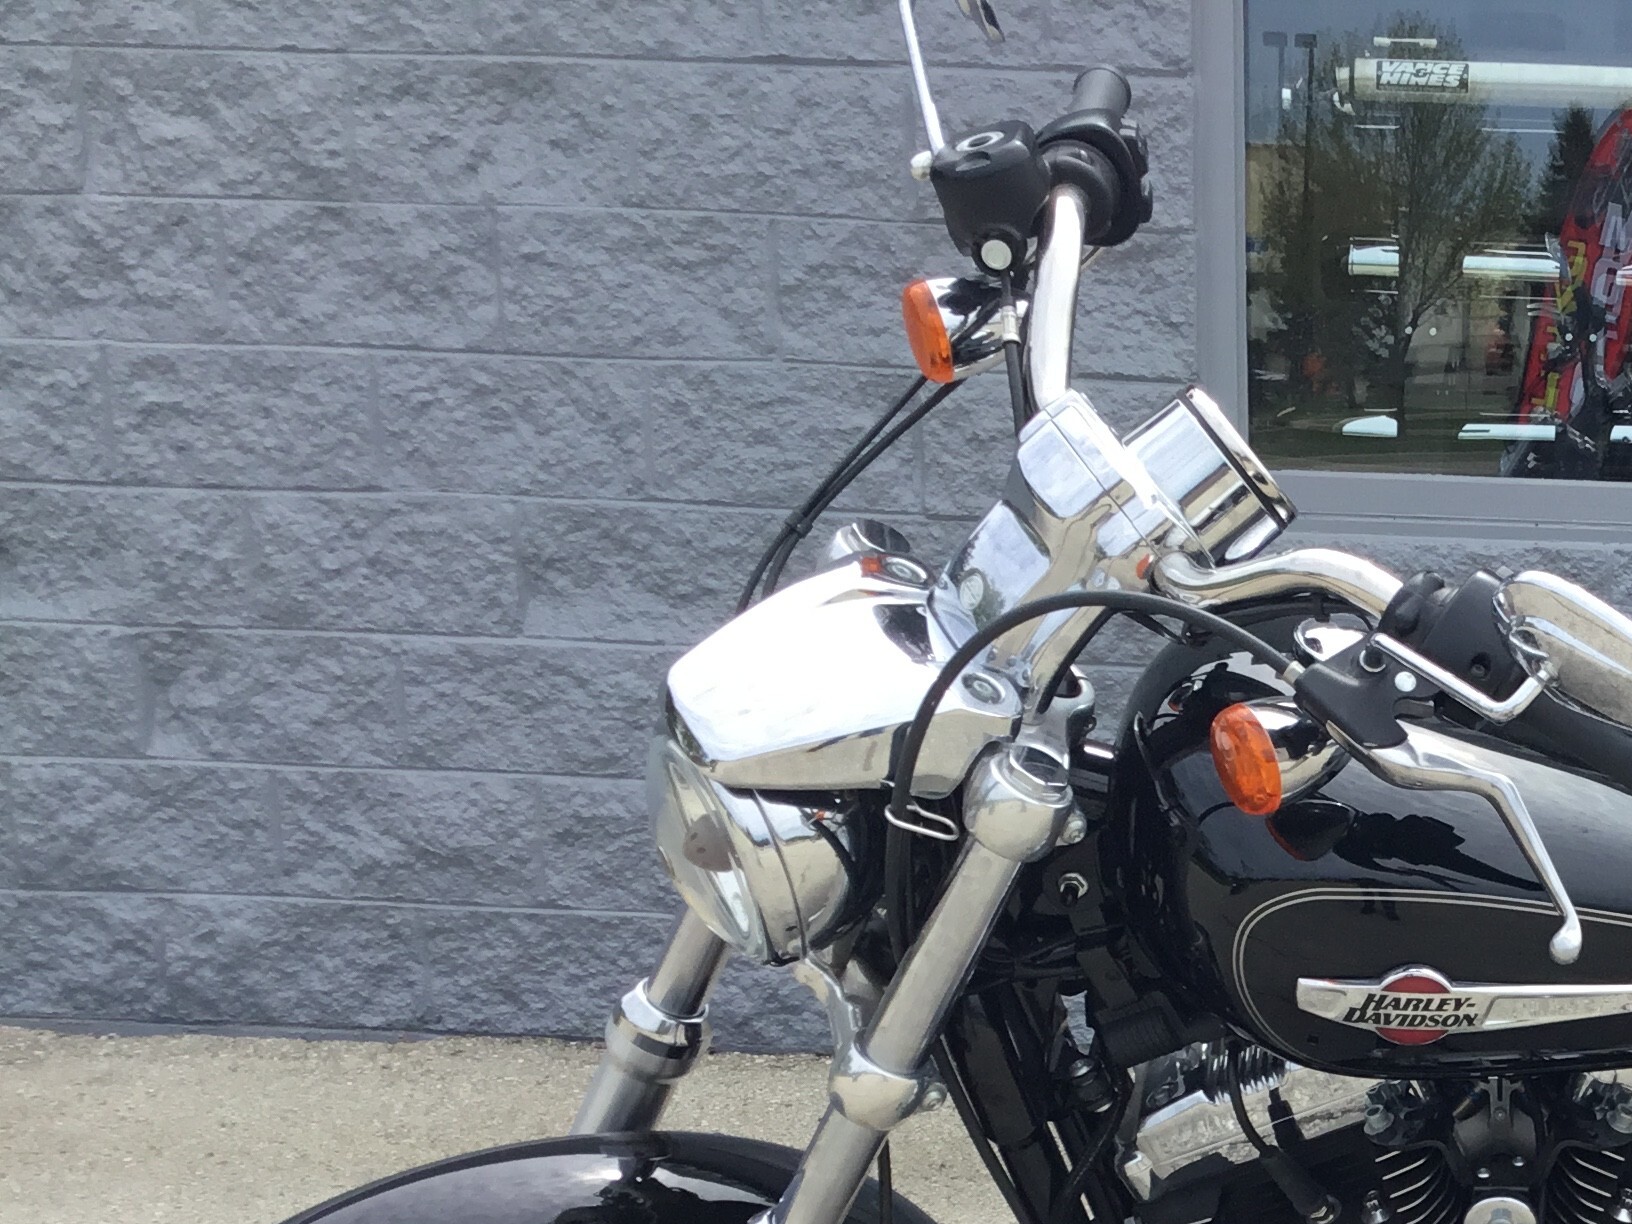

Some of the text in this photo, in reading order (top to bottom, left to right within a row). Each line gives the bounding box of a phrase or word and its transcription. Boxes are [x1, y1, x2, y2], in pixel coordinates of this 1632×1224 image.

[1381, 61, 1466, 75] VANCE
[1379, 72, 1462, 88] HINES
[1358, 992, 1477, 1012] HARLEY-
[1342, 1006, 1478, 1028] DAVIDSON
